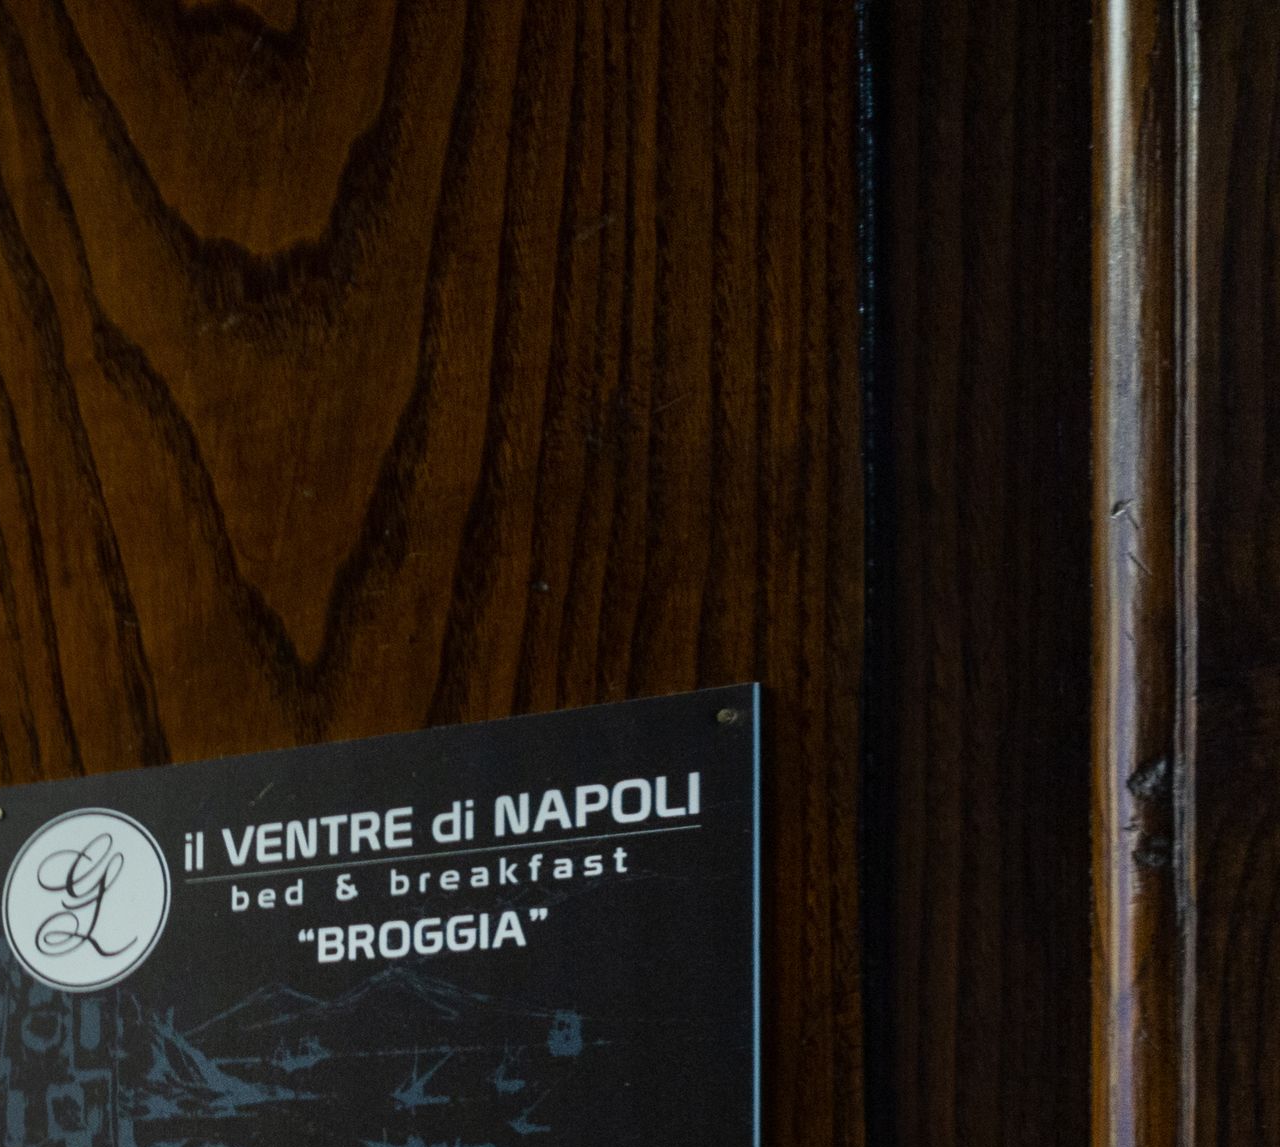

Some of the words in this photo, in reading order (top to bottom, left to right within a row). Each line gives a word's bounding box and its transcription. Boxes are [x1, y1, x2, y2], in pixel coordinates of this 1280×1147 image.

[185, 831, 203, 872] il
[222, 806, 414, 867] VENTRE
[432, 800, 475, 844] di
[494, 772, 701, 835] NAPOLI
[230, 878, 304, 913] bed
[335, 873, 358, 901] &
[390, 847, 631, 896] breakfast
